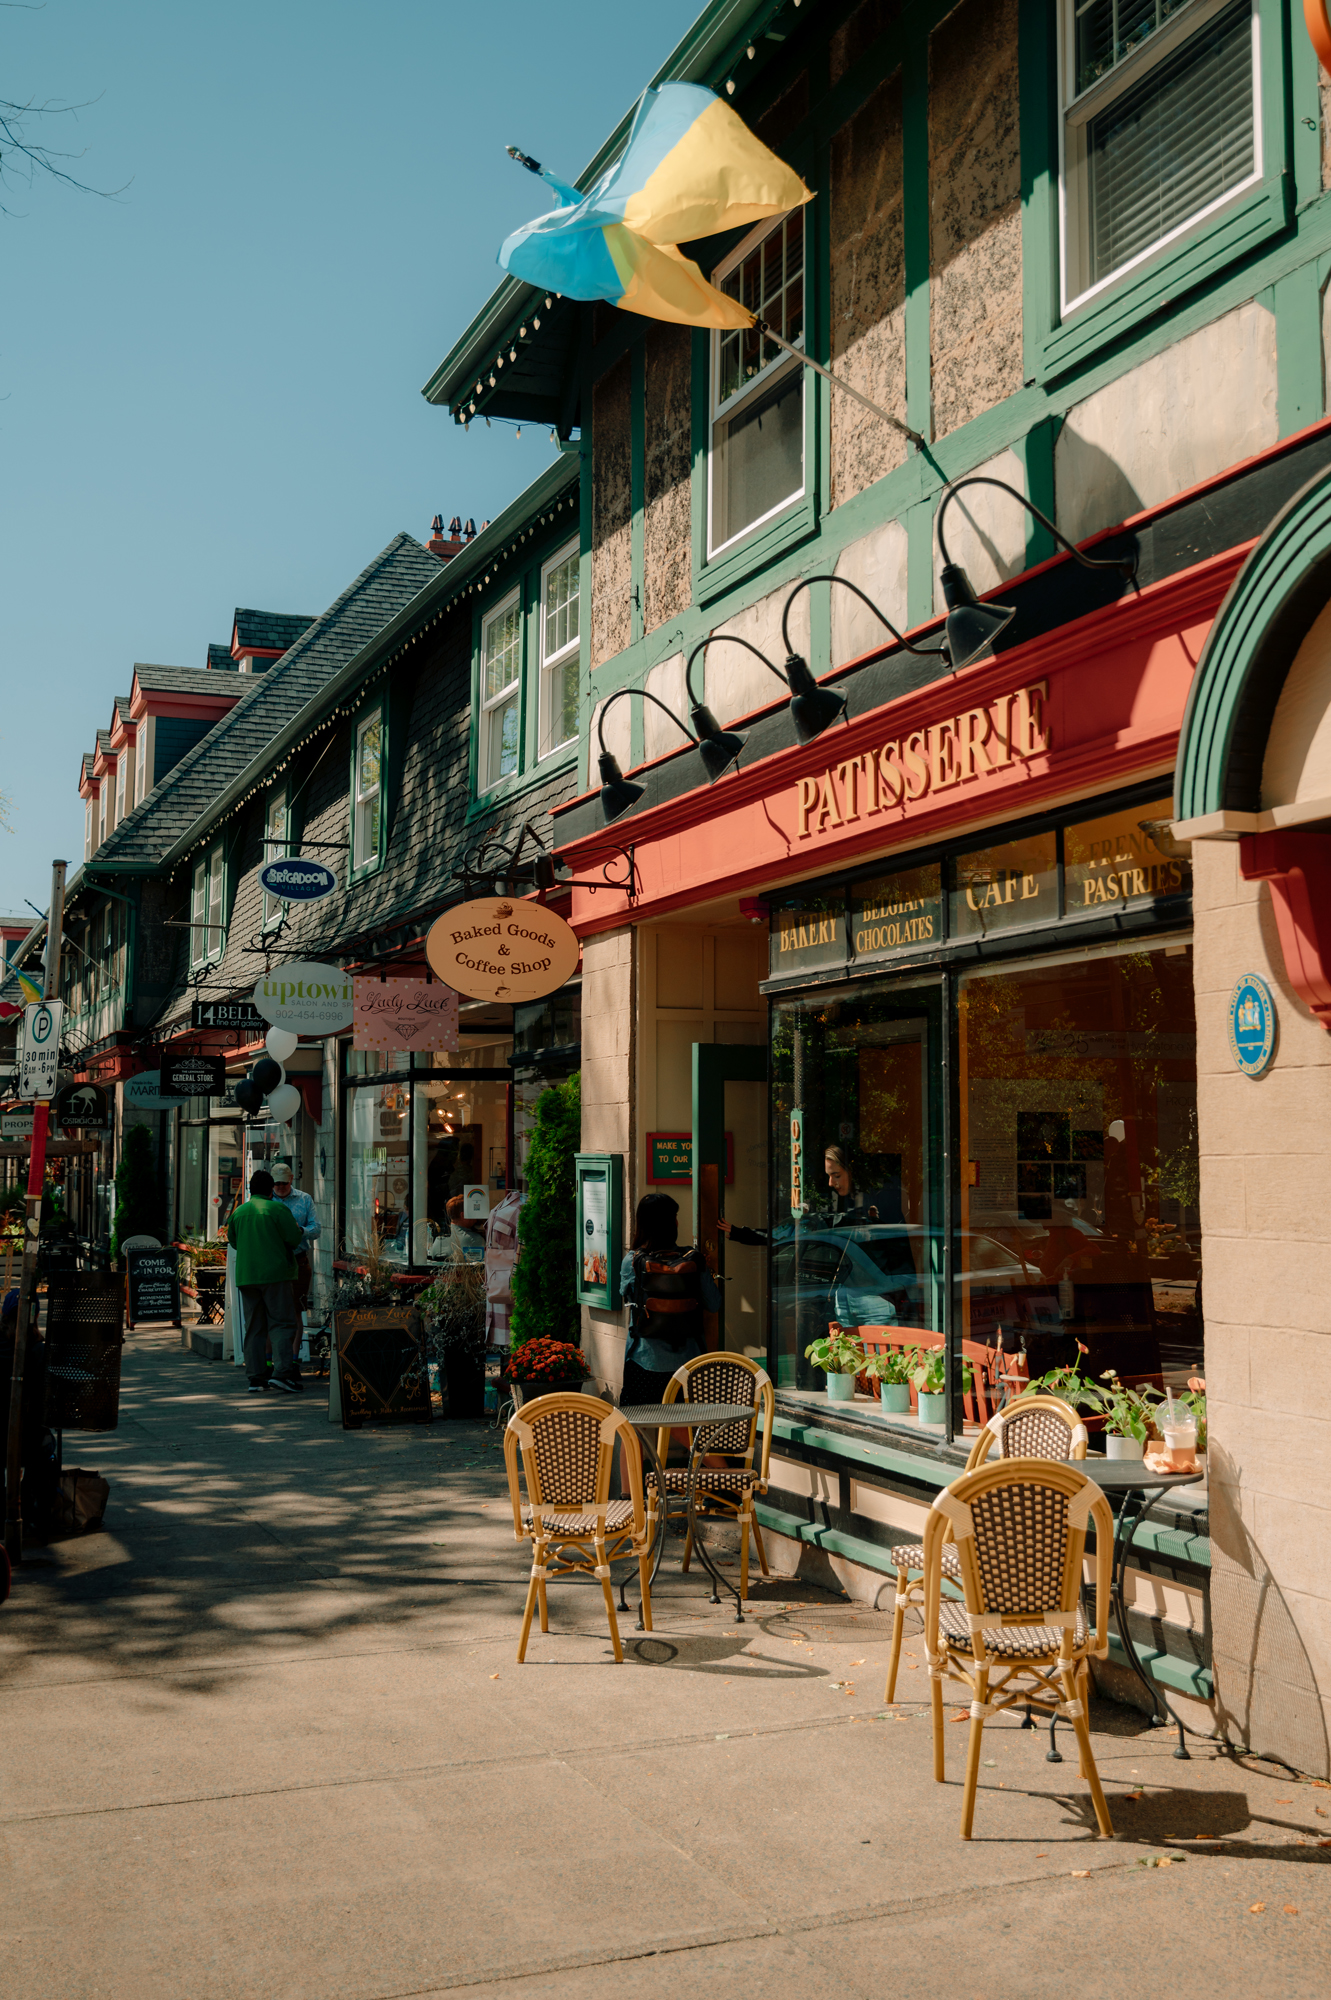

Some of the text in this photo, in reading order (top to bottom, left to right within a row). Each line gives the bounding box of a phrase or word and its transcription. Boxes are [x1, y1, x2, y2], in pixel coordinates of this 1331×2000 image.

[795, 680, 1050, 837] PATISSERIE
[1088, 826, 1174, 869] FRENCH
[267, 869, 328, 886] BRIGADOON
[1083, 859, 1182, 906] PASTRIES
[862, 889, 925, 922] BELGIAN
[450, 923, 556, 948] Baked Goods
[780, 908, 838, 952] BAKERY
[856, 915, 933, 952] CHOCOLATES
[498, 944, 511, 956] &
[455, 952, 551, 974] Coffee Shop
[263, 979, 353, 1005] uptown
[361, 991, 450, 1016] Lady Luck
[196, 1005, 264, 1026] 14 BELLS
[216, 1018, 229, 1026] fine
[241, 1019, 264, 1028] gallery
[275, 1009, 343, 1021] 902-454-6996
[39, 1017, 48, 1038] P
[1063, 1033, 1089, 1054] 25
[25, 1050, 55, 1062] 30 min
[172, 1074, 214, 1082] GENERAL STORE
[62, 1117, 104, 1125] OSTRICH CLUB
[657, 1141, 678, 1150] MAKE
[658, 1155, 688, 1163] TO OUR
[791, 1119, 801, 1208] OPEN
[139, 1259, 165, 1267] COME
[144, 1267, 175, 1275] IN FOR
[344, 1309, 377, 1327] Lady
